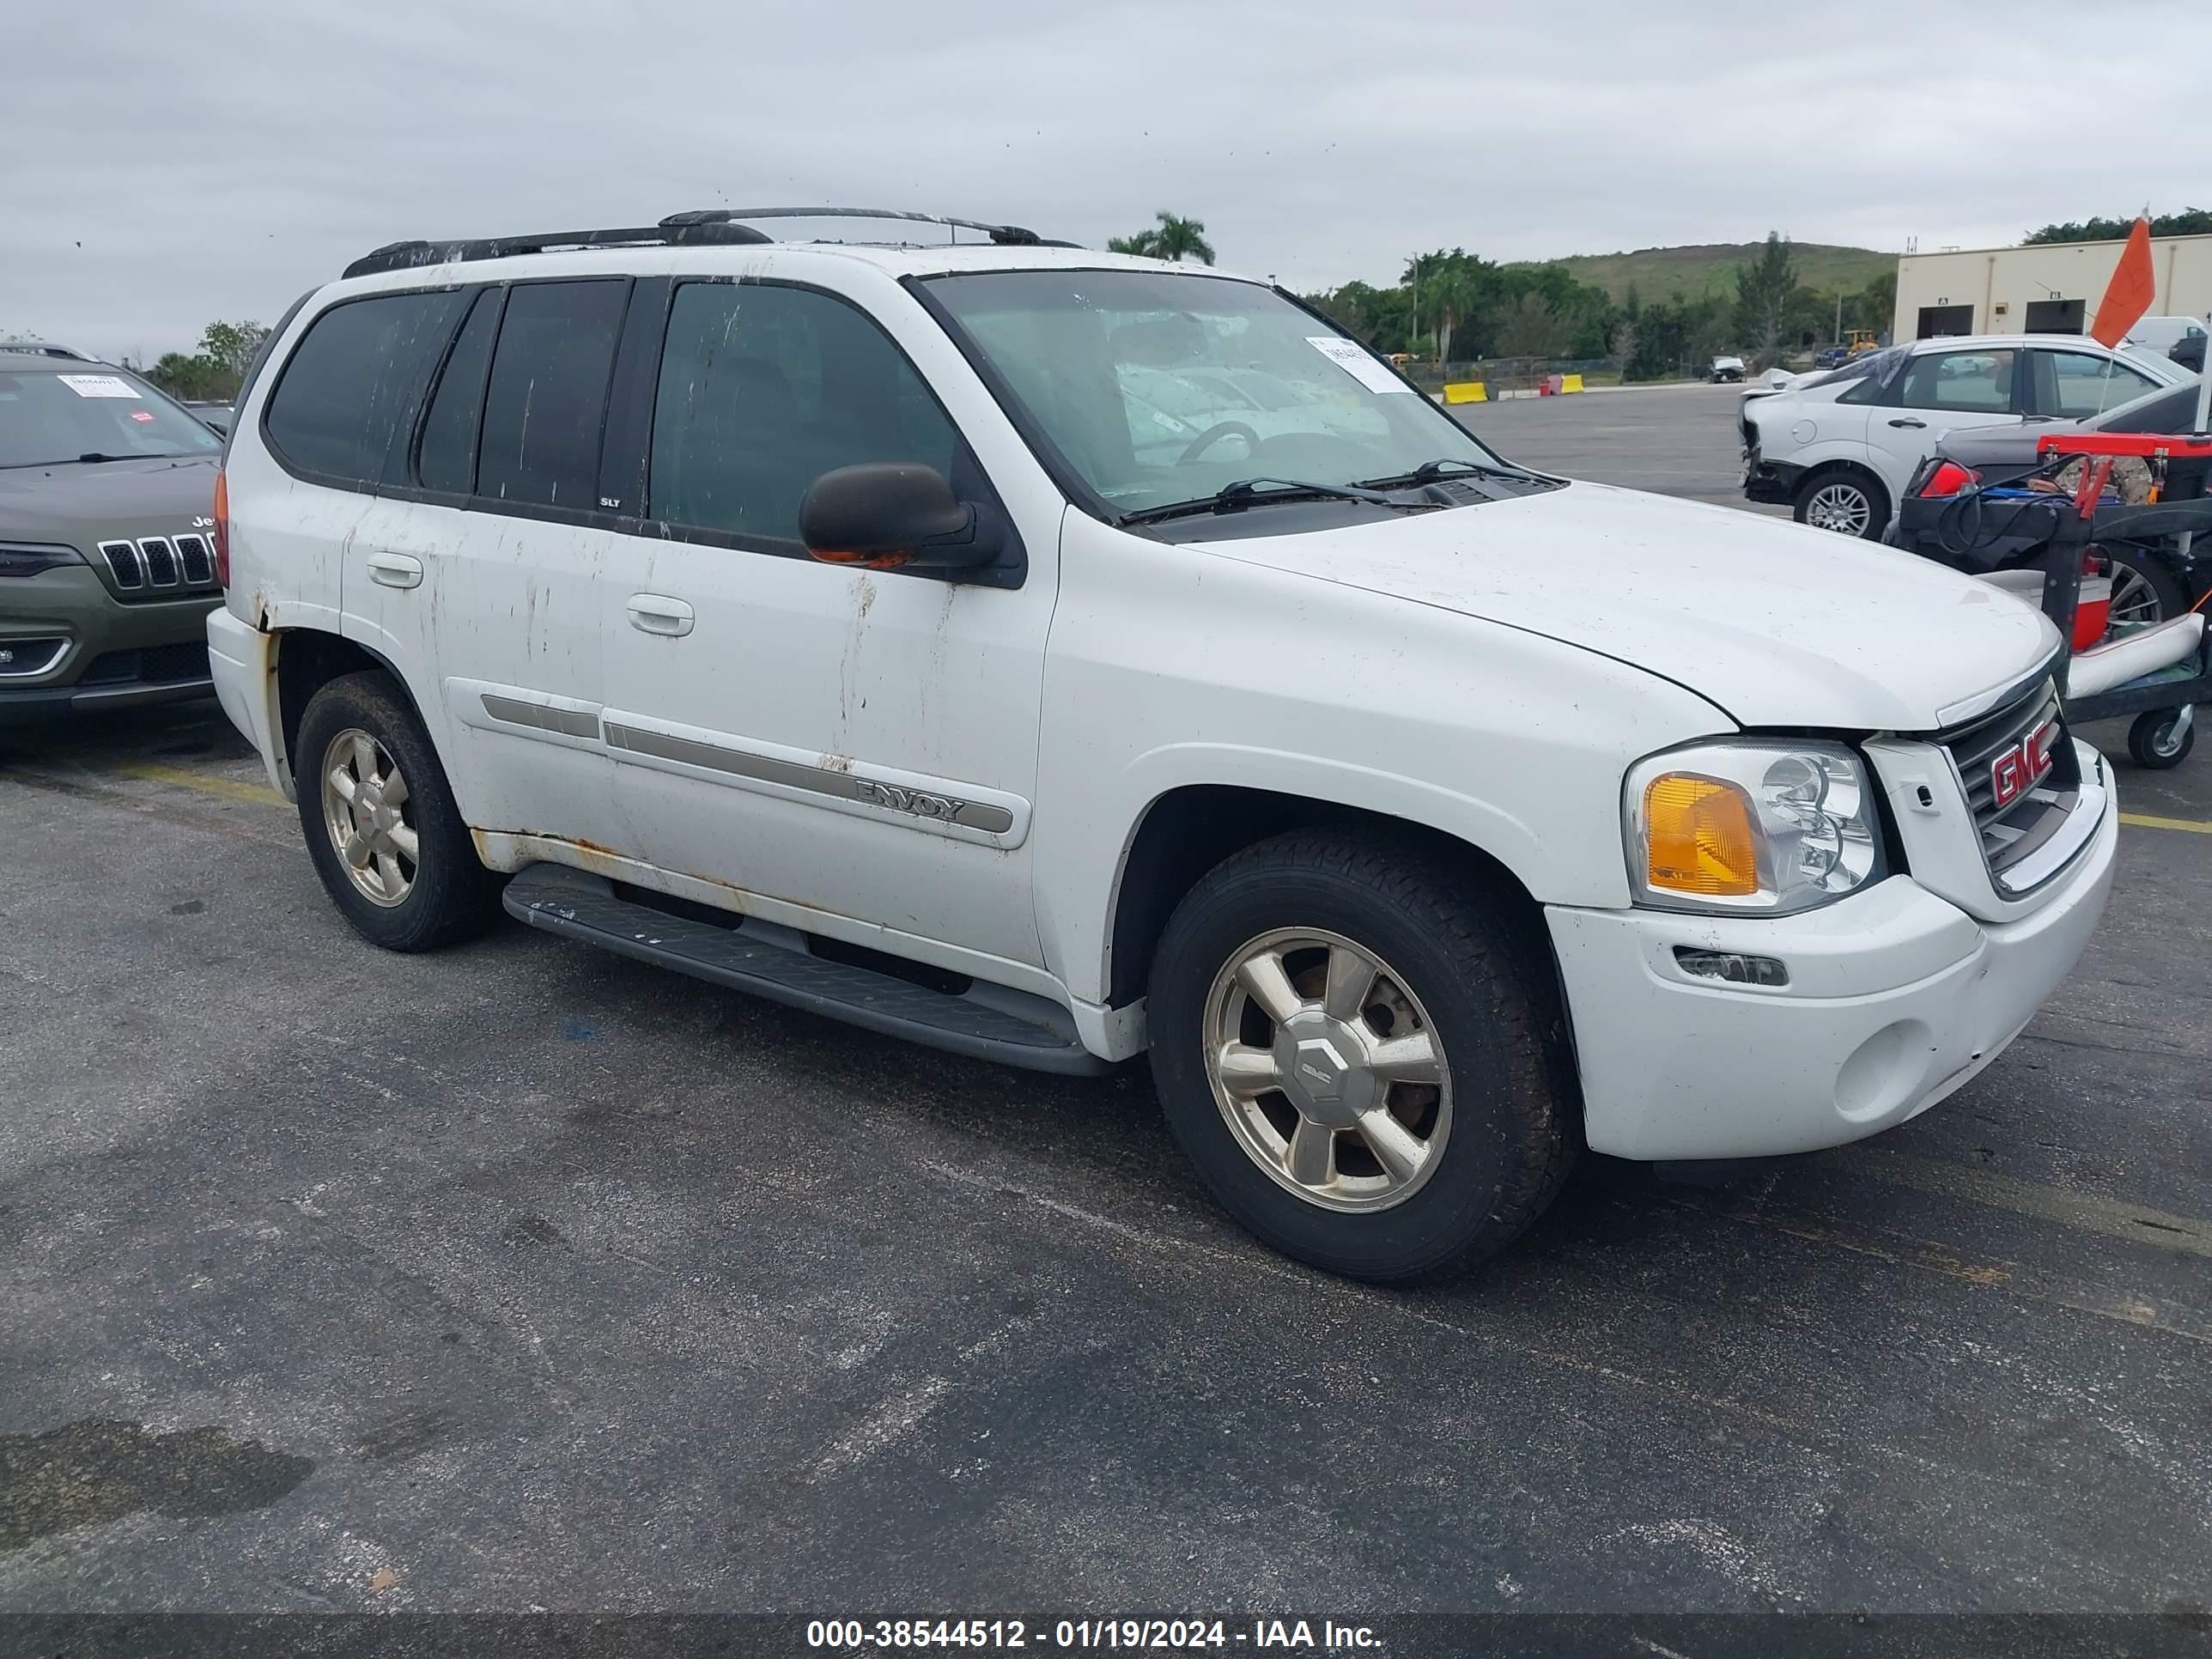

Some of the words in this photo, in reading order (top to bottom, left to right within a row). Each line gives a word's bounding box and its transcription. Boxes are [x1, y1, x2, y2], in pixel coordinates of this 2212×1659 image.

[600, 497, 620, 508] SLT
[191, 515, 216, 527] Je
[1991, 720, 2053, 808] GMC
[855, 779, 964, 822] ENVOY
